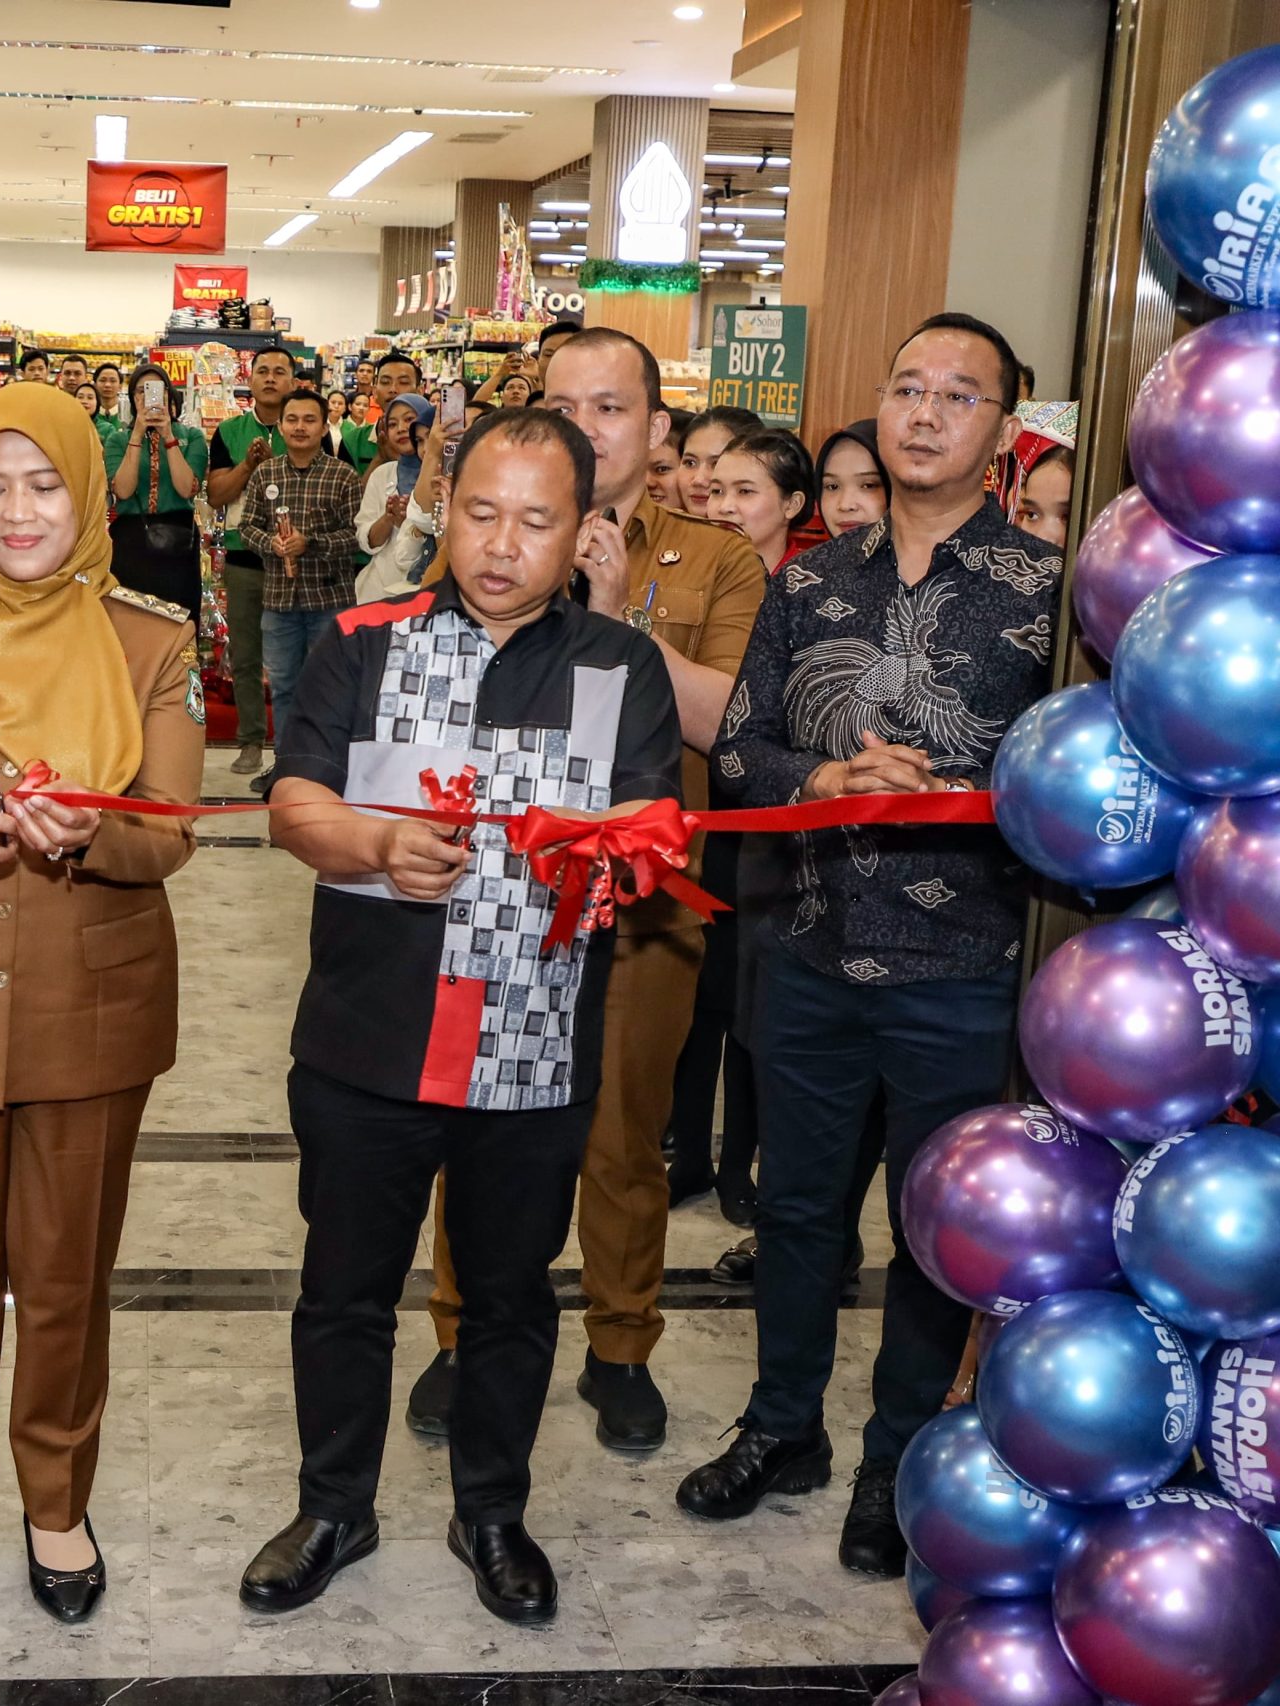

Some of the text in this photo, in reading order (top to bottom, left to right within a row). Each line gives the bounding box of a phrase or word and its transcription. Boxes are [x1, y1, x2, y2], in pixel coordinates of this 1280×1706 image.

[134, 189, 167, 203] BELI
[107, 205, 203, 228] GRATIS 1
[182, 288, 229, 300] GRATIS
[535, 286, 586, 313] foo
[154, 359, 195, 381] RATI
[729, 343, 785, 377] BUY 2
[712, 379, 798, 414] GET 1 FREE
[1133, 773, 1152, 845] SUPERMARKET
[1156, 925, 1232, 1047] HORAS!
[1220, 966, 1252, 1056] SIAN
[1210, 1347, 1244, 1500] SIANTAR
[1234, 1357, 1276, 1504] HORAS!
